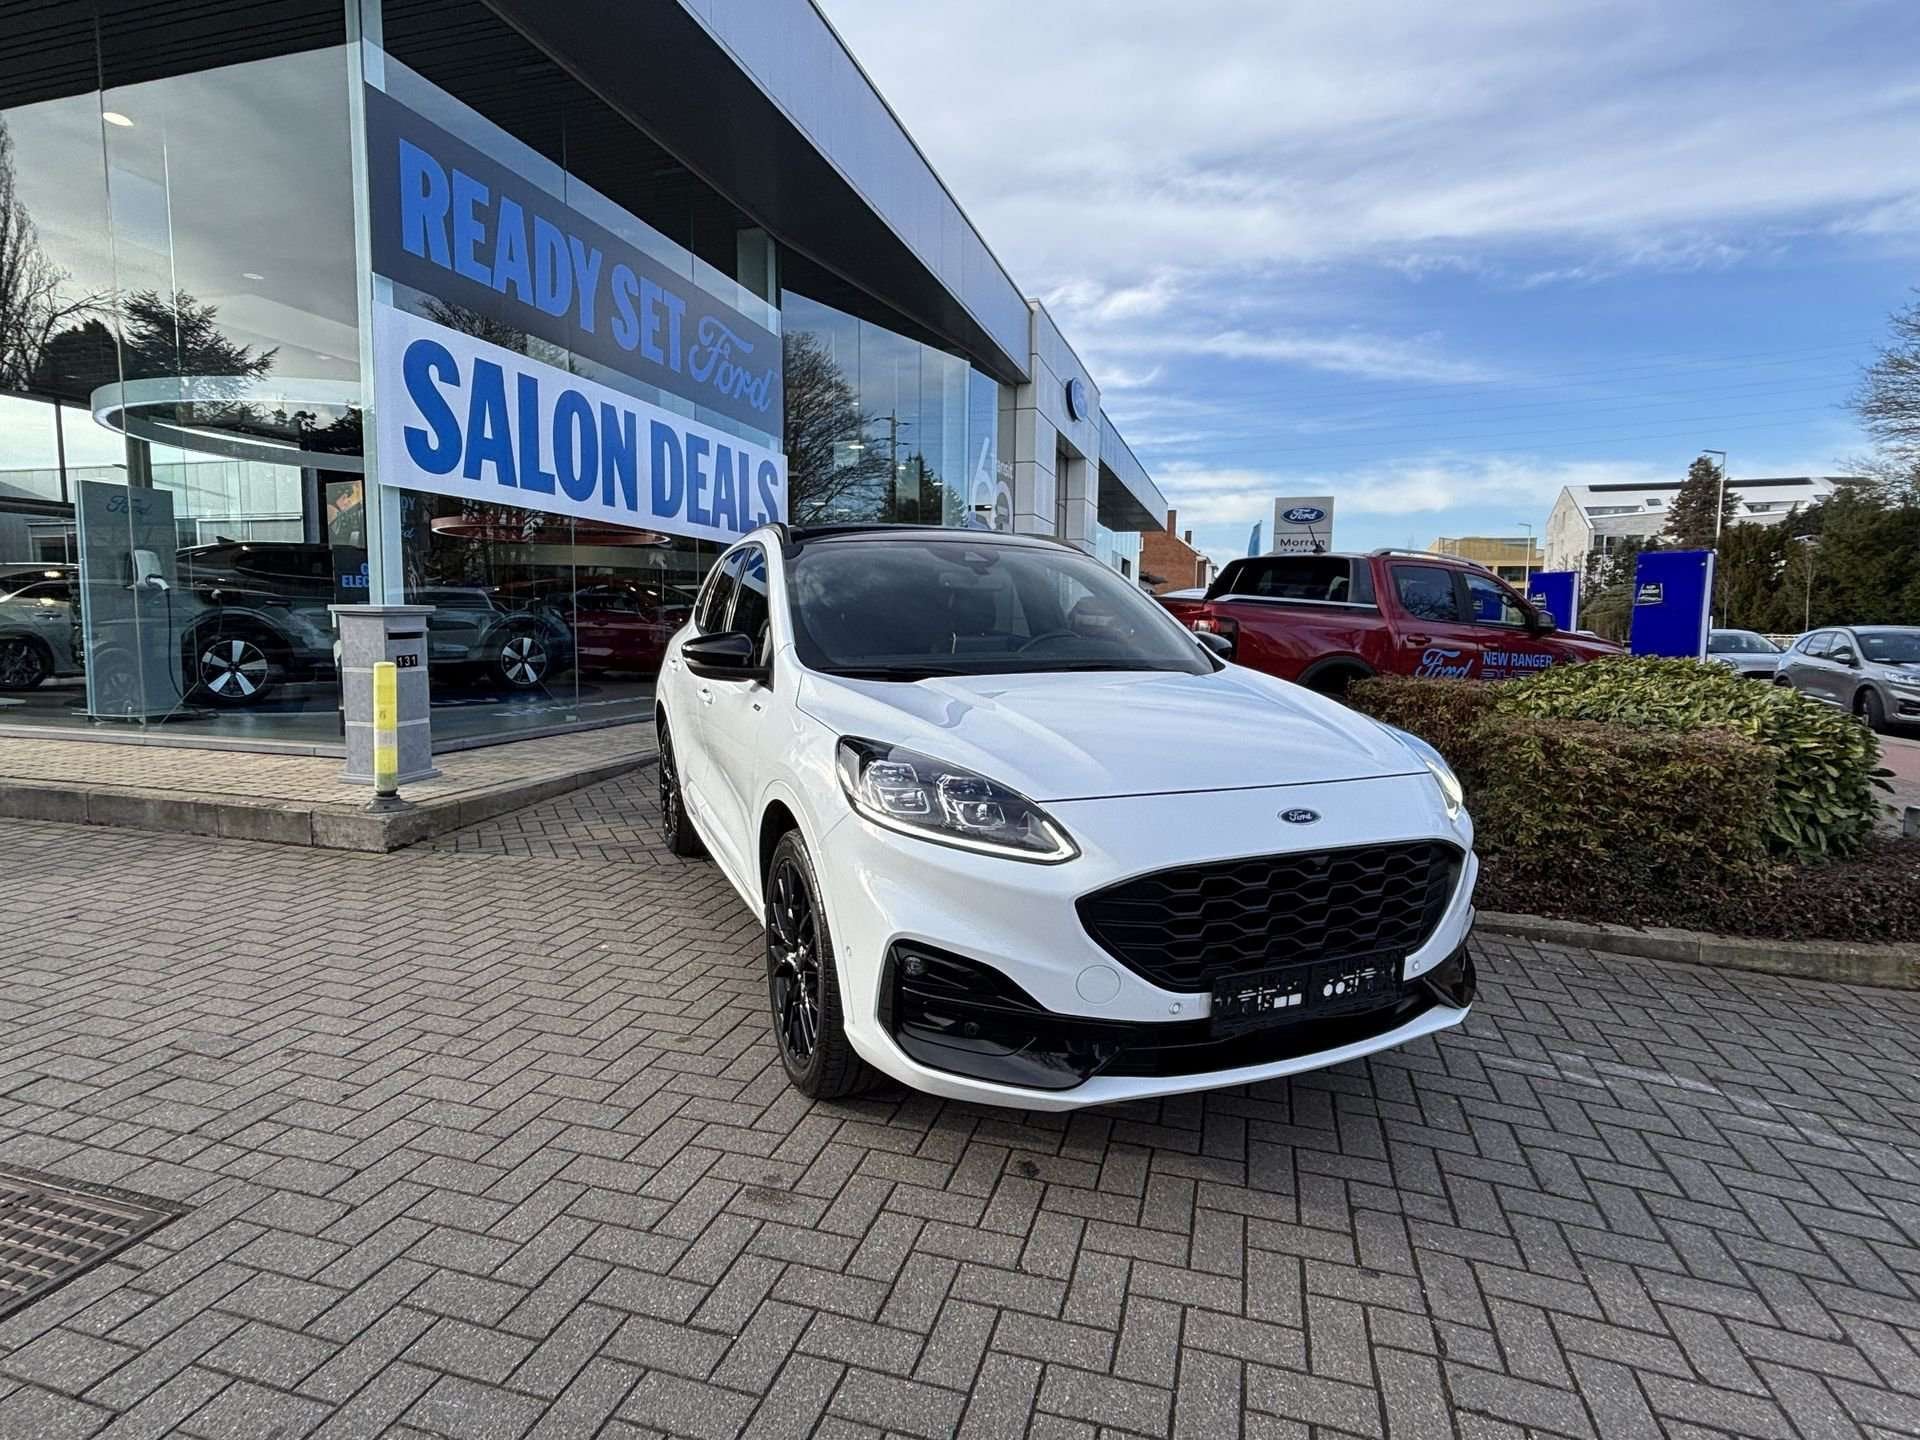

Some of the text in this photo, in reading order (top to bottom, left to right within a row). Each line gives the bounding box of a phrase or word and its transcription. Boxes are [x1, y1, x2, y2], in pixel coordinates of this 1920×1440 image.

[400, 138, 777, 413] READY SET Ford
[403, 339, 779, 533] SALON DEALS
[1289, 508, 1318, 520] Ford
[398, 655, 417, 666] 131
[1483, 652, 1553, 668] NEW RANGER
